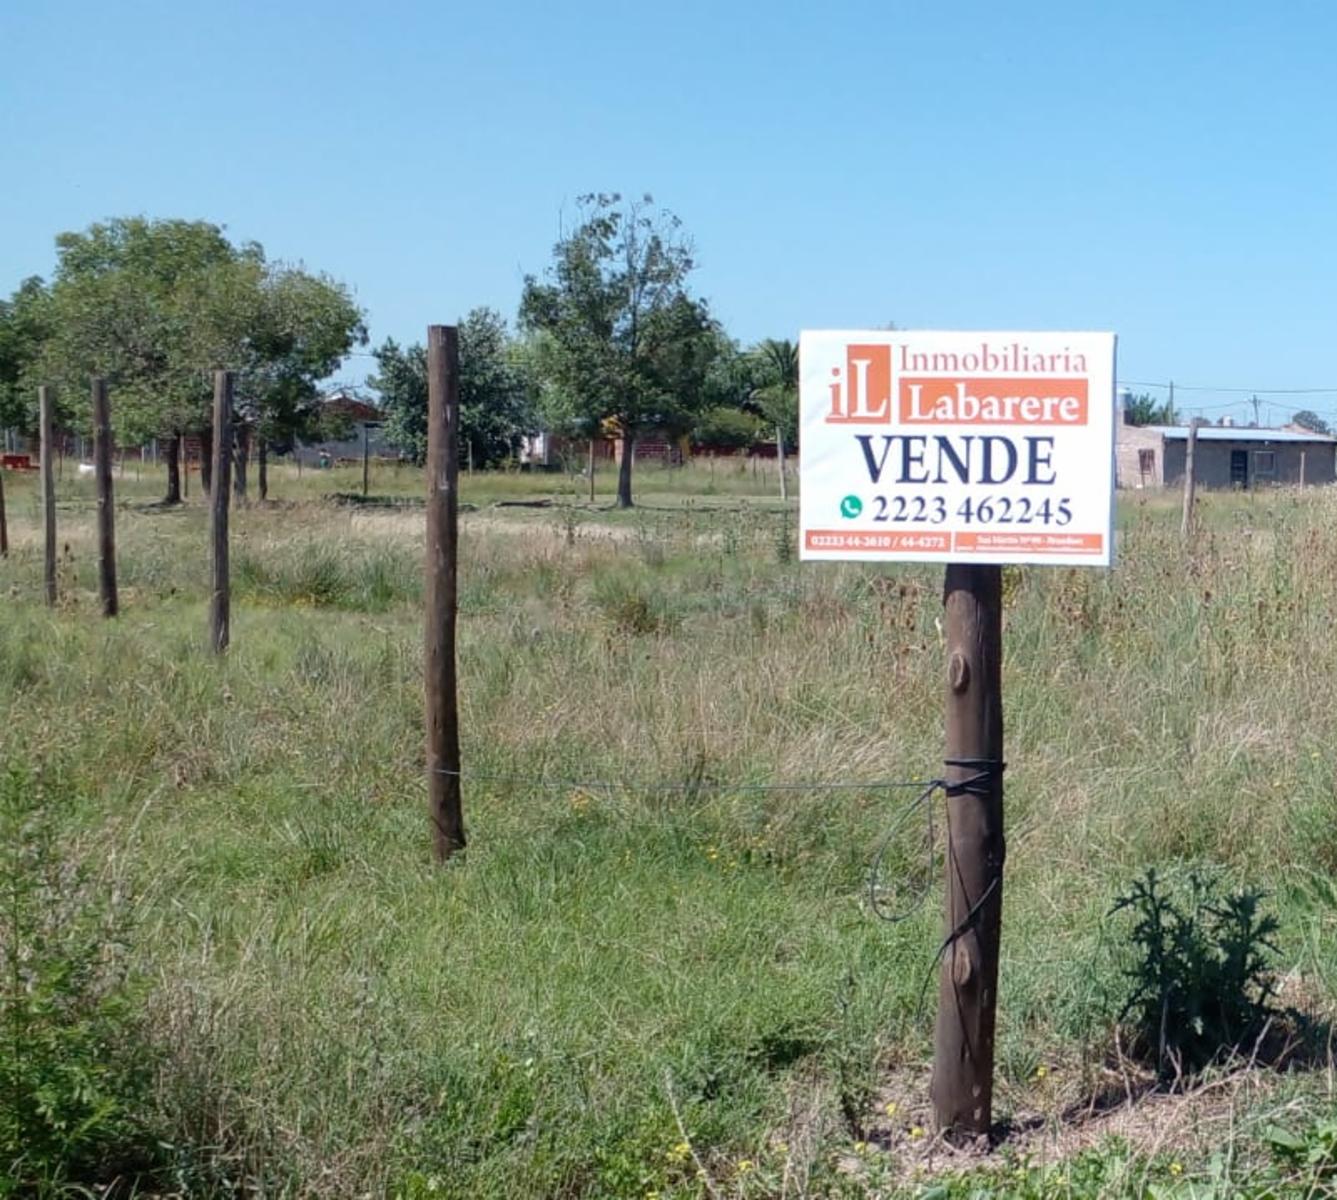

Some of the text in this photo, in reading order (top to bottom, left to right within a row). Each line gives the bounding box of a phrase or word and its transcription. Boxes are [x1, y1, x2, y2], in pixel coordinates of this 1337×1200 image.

[900, 343, 1088, 373] Inmobiliaria
[907, 382, 1080, 422] Labarere
[854, 434, 1057, 485] VENDE
[873, 495, 1072, 526] 2223 462245
